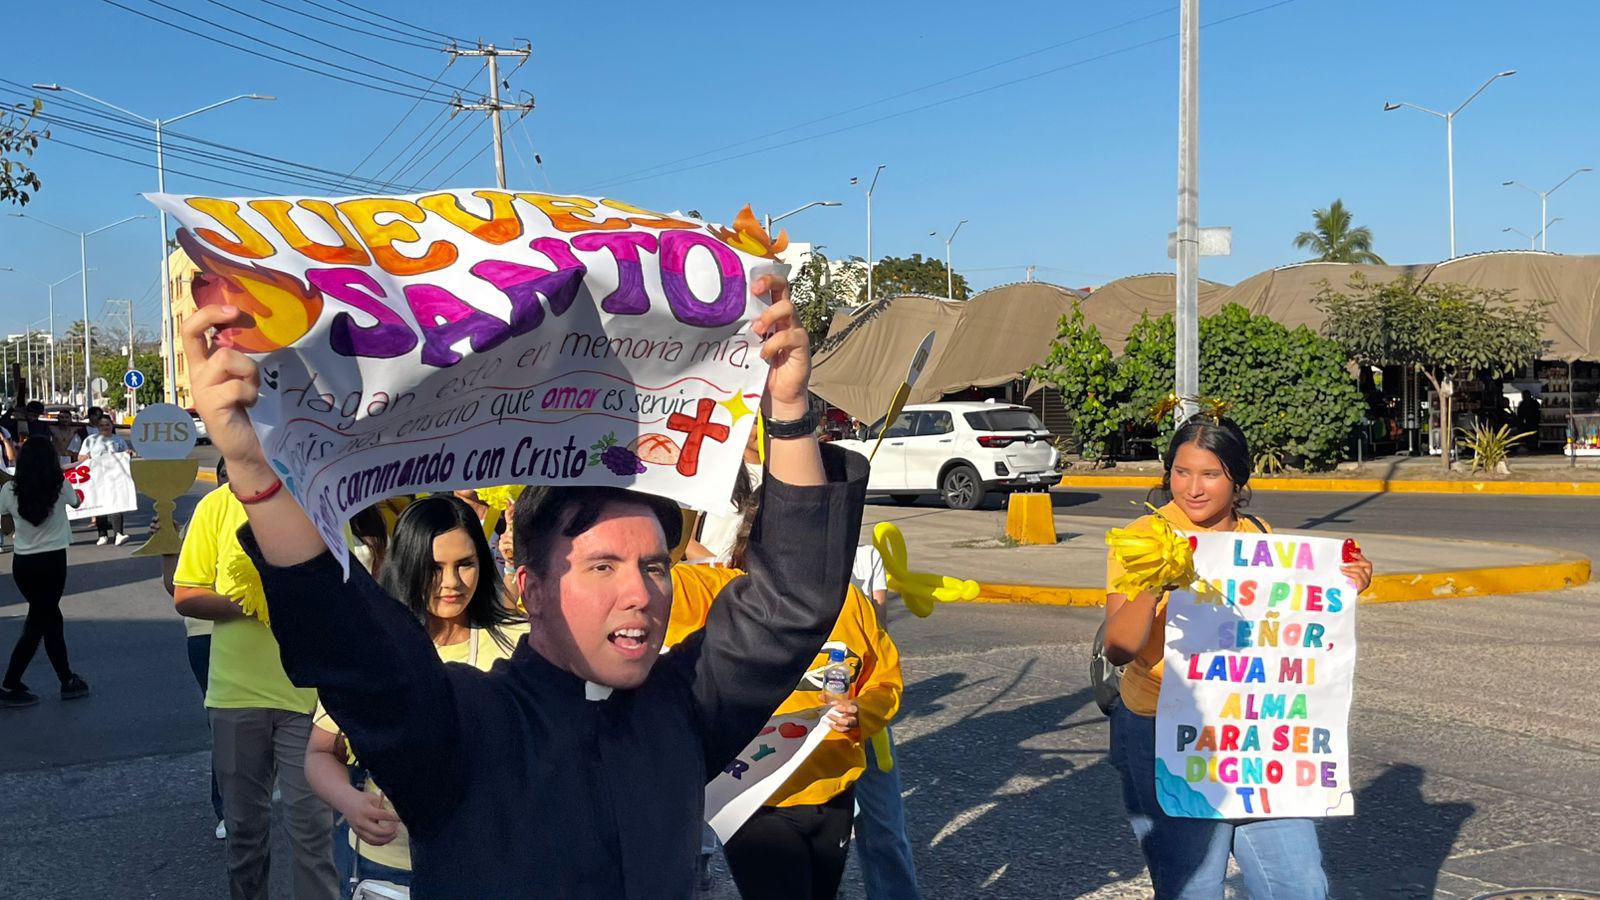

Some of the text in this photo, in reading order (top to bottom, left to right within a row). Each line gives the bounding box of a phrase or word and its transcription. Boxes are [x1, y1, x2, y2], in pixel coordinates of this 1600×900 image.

[305, 230, 746, 367] SANTO
[517, 341, 551, 368] en
[560, 331, 684, 361] memoria
[490, 388, 535, 425] que
[541, 385, 602, 410] amor
[602, 392, 626, 411] es
[631, 389, 696, 415] servir
[139, 422, 189, 443] JHS
[336, 435, 588, 513] caminando con Cristo
[1233, 539, 1315, 570] LAVA
[1268, 582, 1343, 613] PIES
[1217, 611, 1334, 651] SEÑOR,
[1187, 654, 1315, 685] LAVA MI
[1219, 693, 1308, 720] ALMA
[1176, 724, 1332, 754] PARA SER
[1185, 755, 1337, 788] DIGNO DE
[1236, 787, 1271, 814] TI
